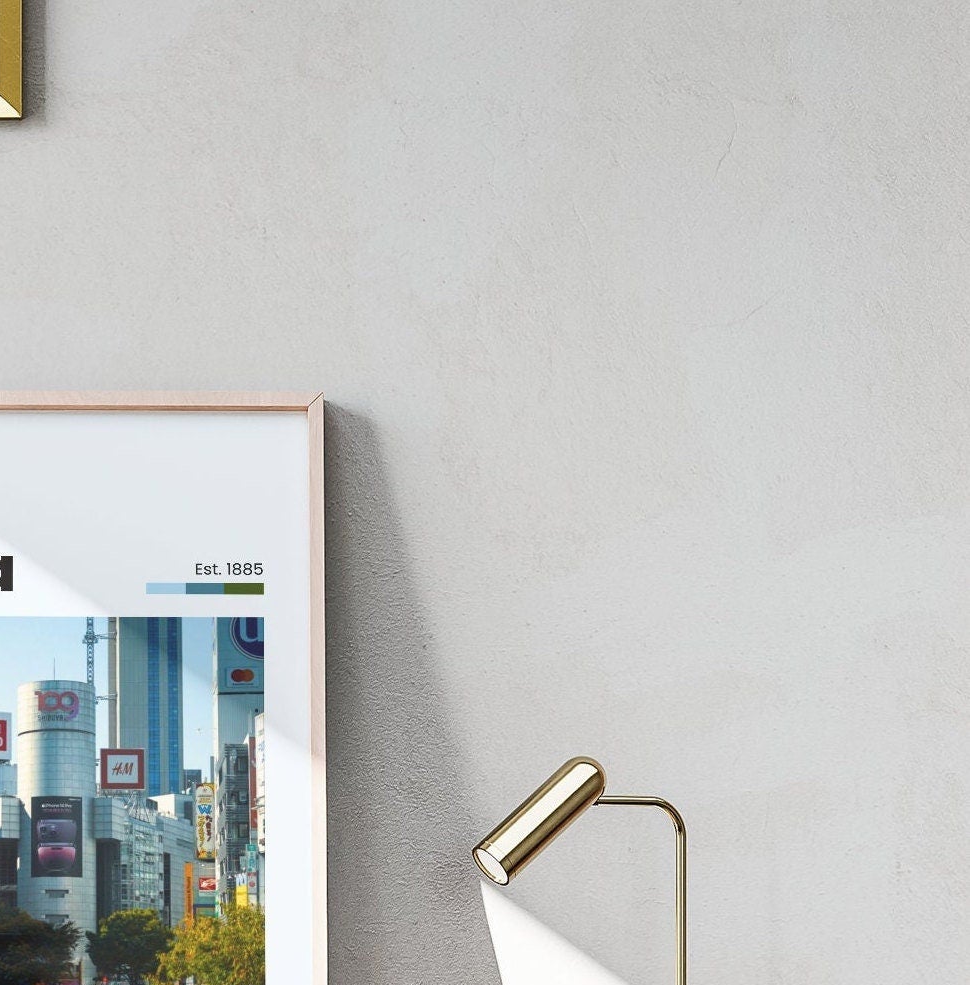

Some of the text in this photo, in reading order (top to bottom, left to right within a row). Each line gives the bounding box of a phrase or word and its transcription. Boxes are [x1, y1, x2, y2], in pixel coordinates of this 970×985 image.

[195, 562, 264, 576] Est. 1885
[34, 690, 79, 720] 109
[112, 762, 134, 776] H&M
